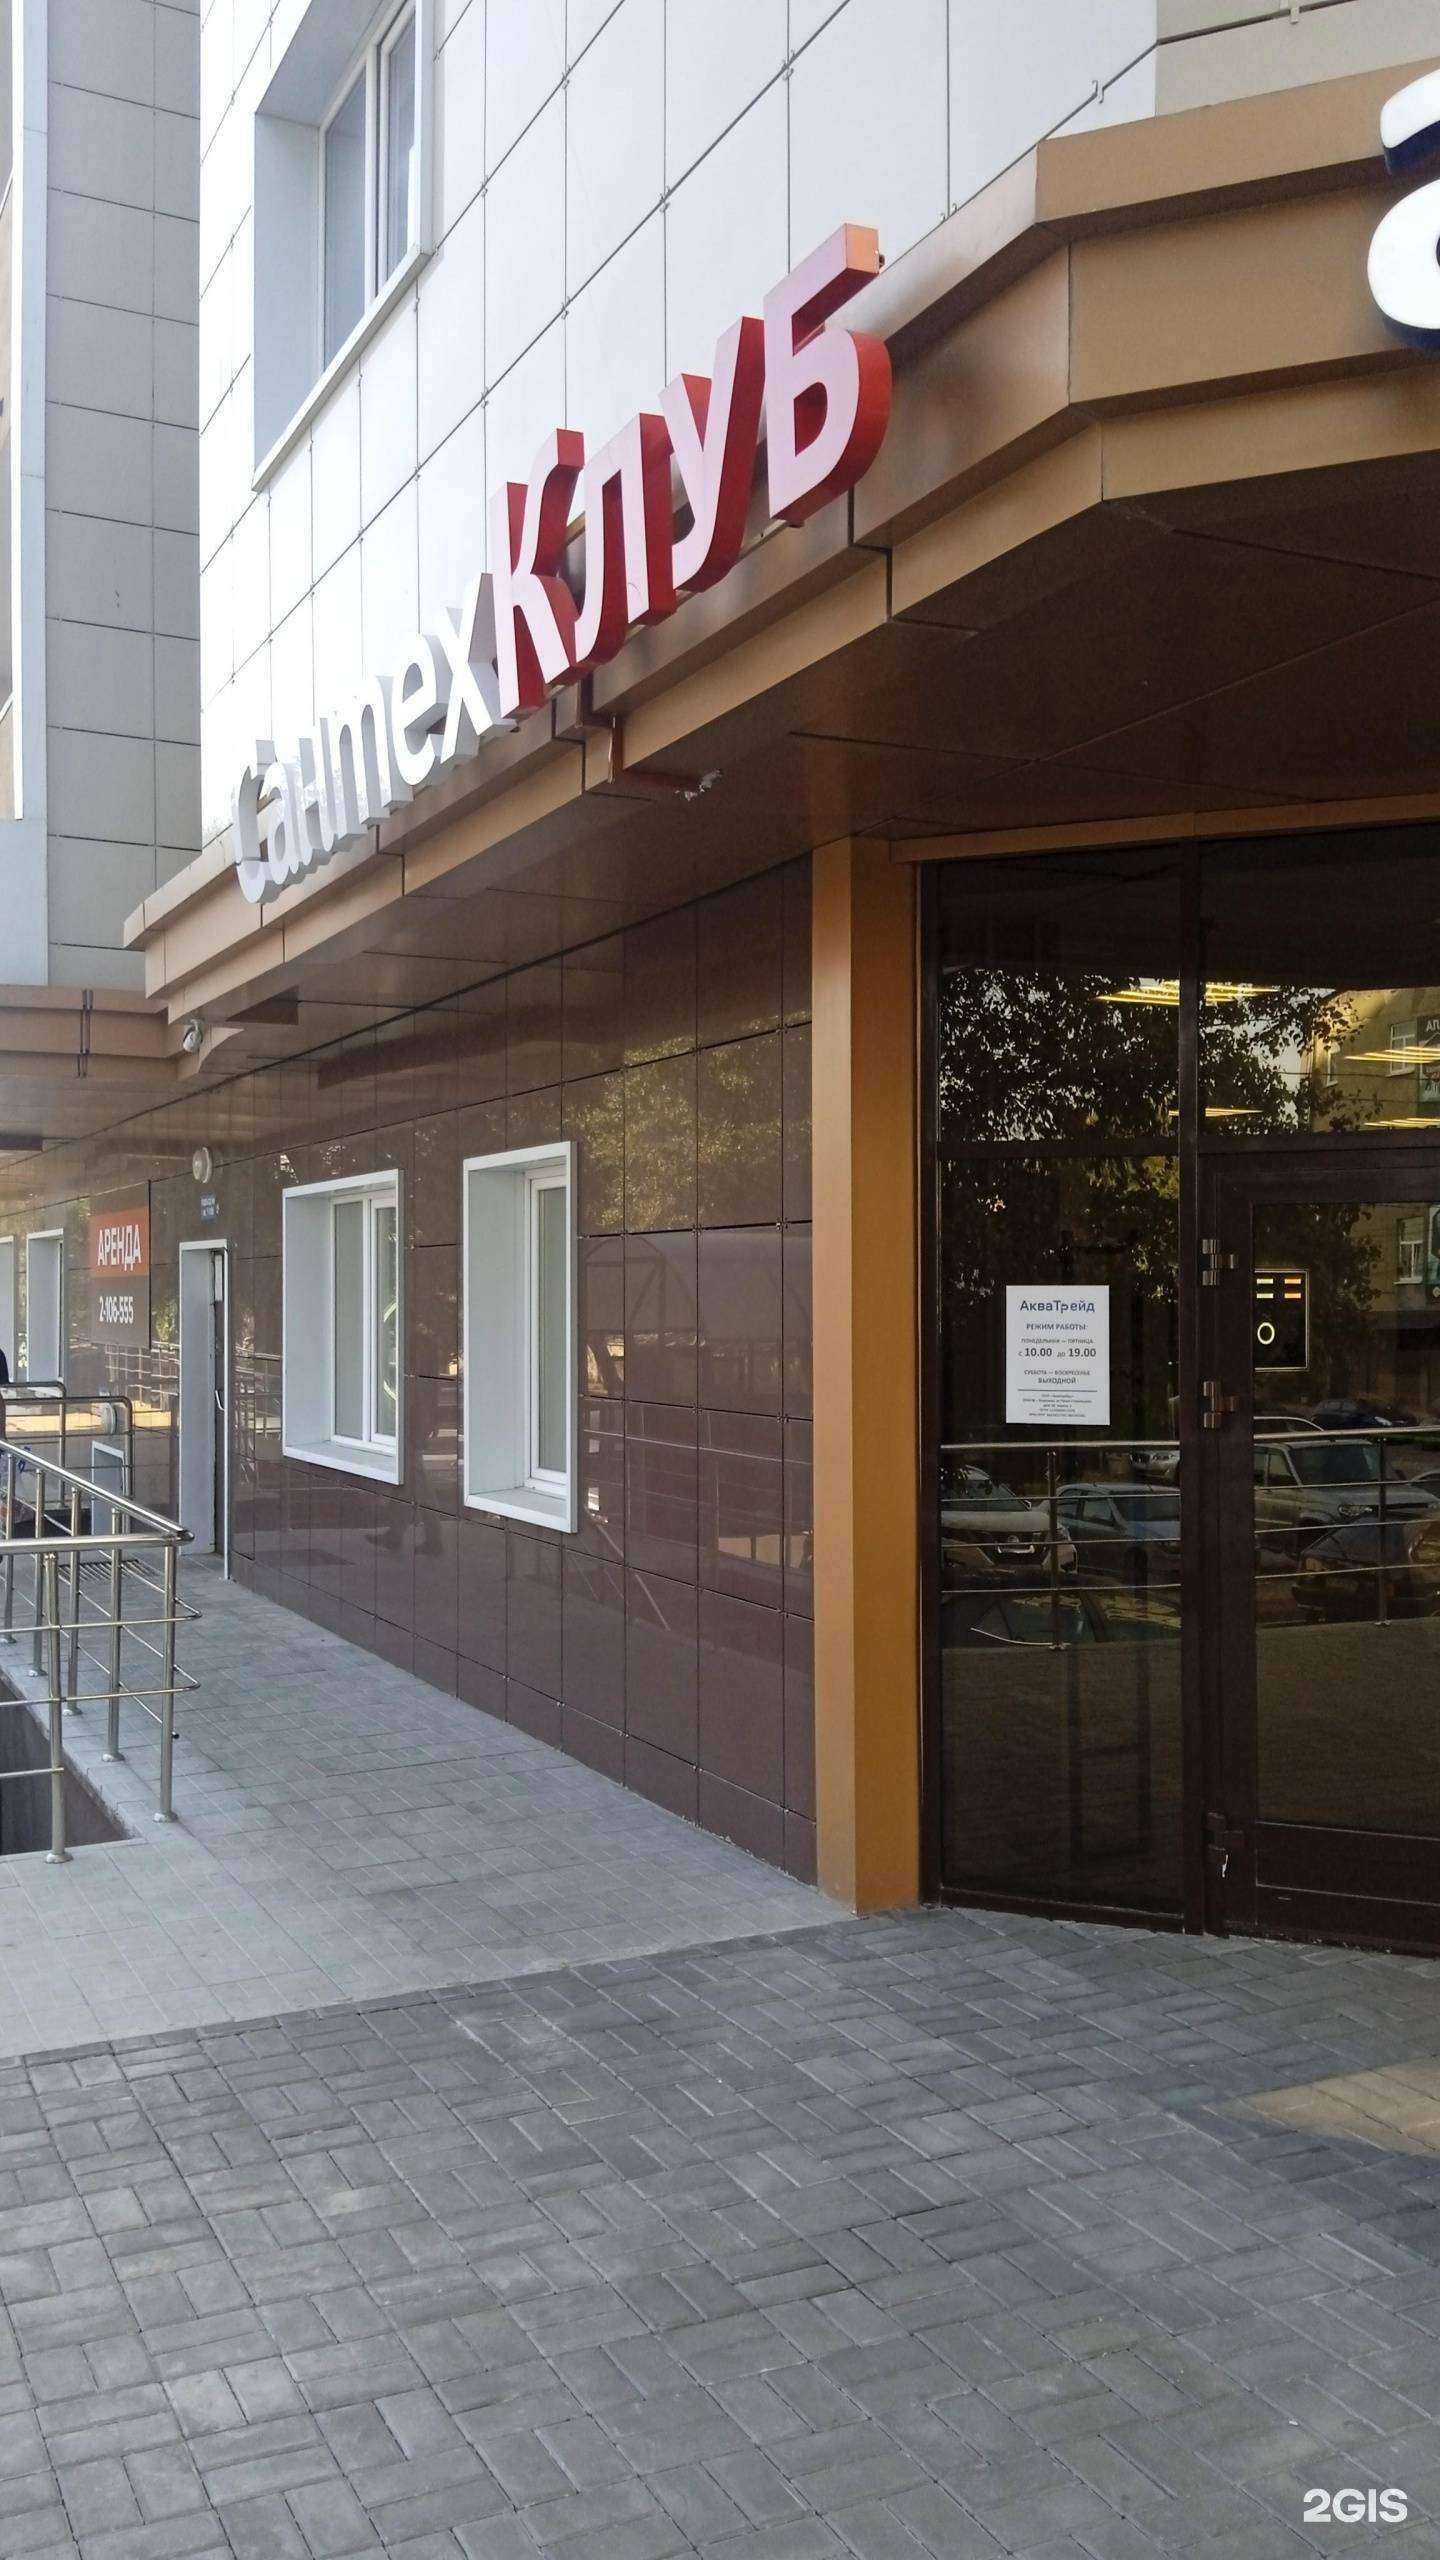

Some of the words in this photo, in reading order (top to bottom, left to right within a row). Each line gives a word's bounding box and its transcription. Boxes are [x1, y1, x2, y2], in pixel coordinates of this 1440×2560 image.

[97, 1224, 142, 1272] АРЕНДА
[99, 1296, 134, 1325] 2-106-555
[1019, 1299, 1096, 1314] АкваТрейд
[1026, 1323, 1054, 1331] РЕЖИМ
[1024, 1347, 1053, 1357] 10.00
[1068, 1347, 1097, 1358] 19.00
[1038, 1377, 1077, 1385] ВЫХОДНОЙ
